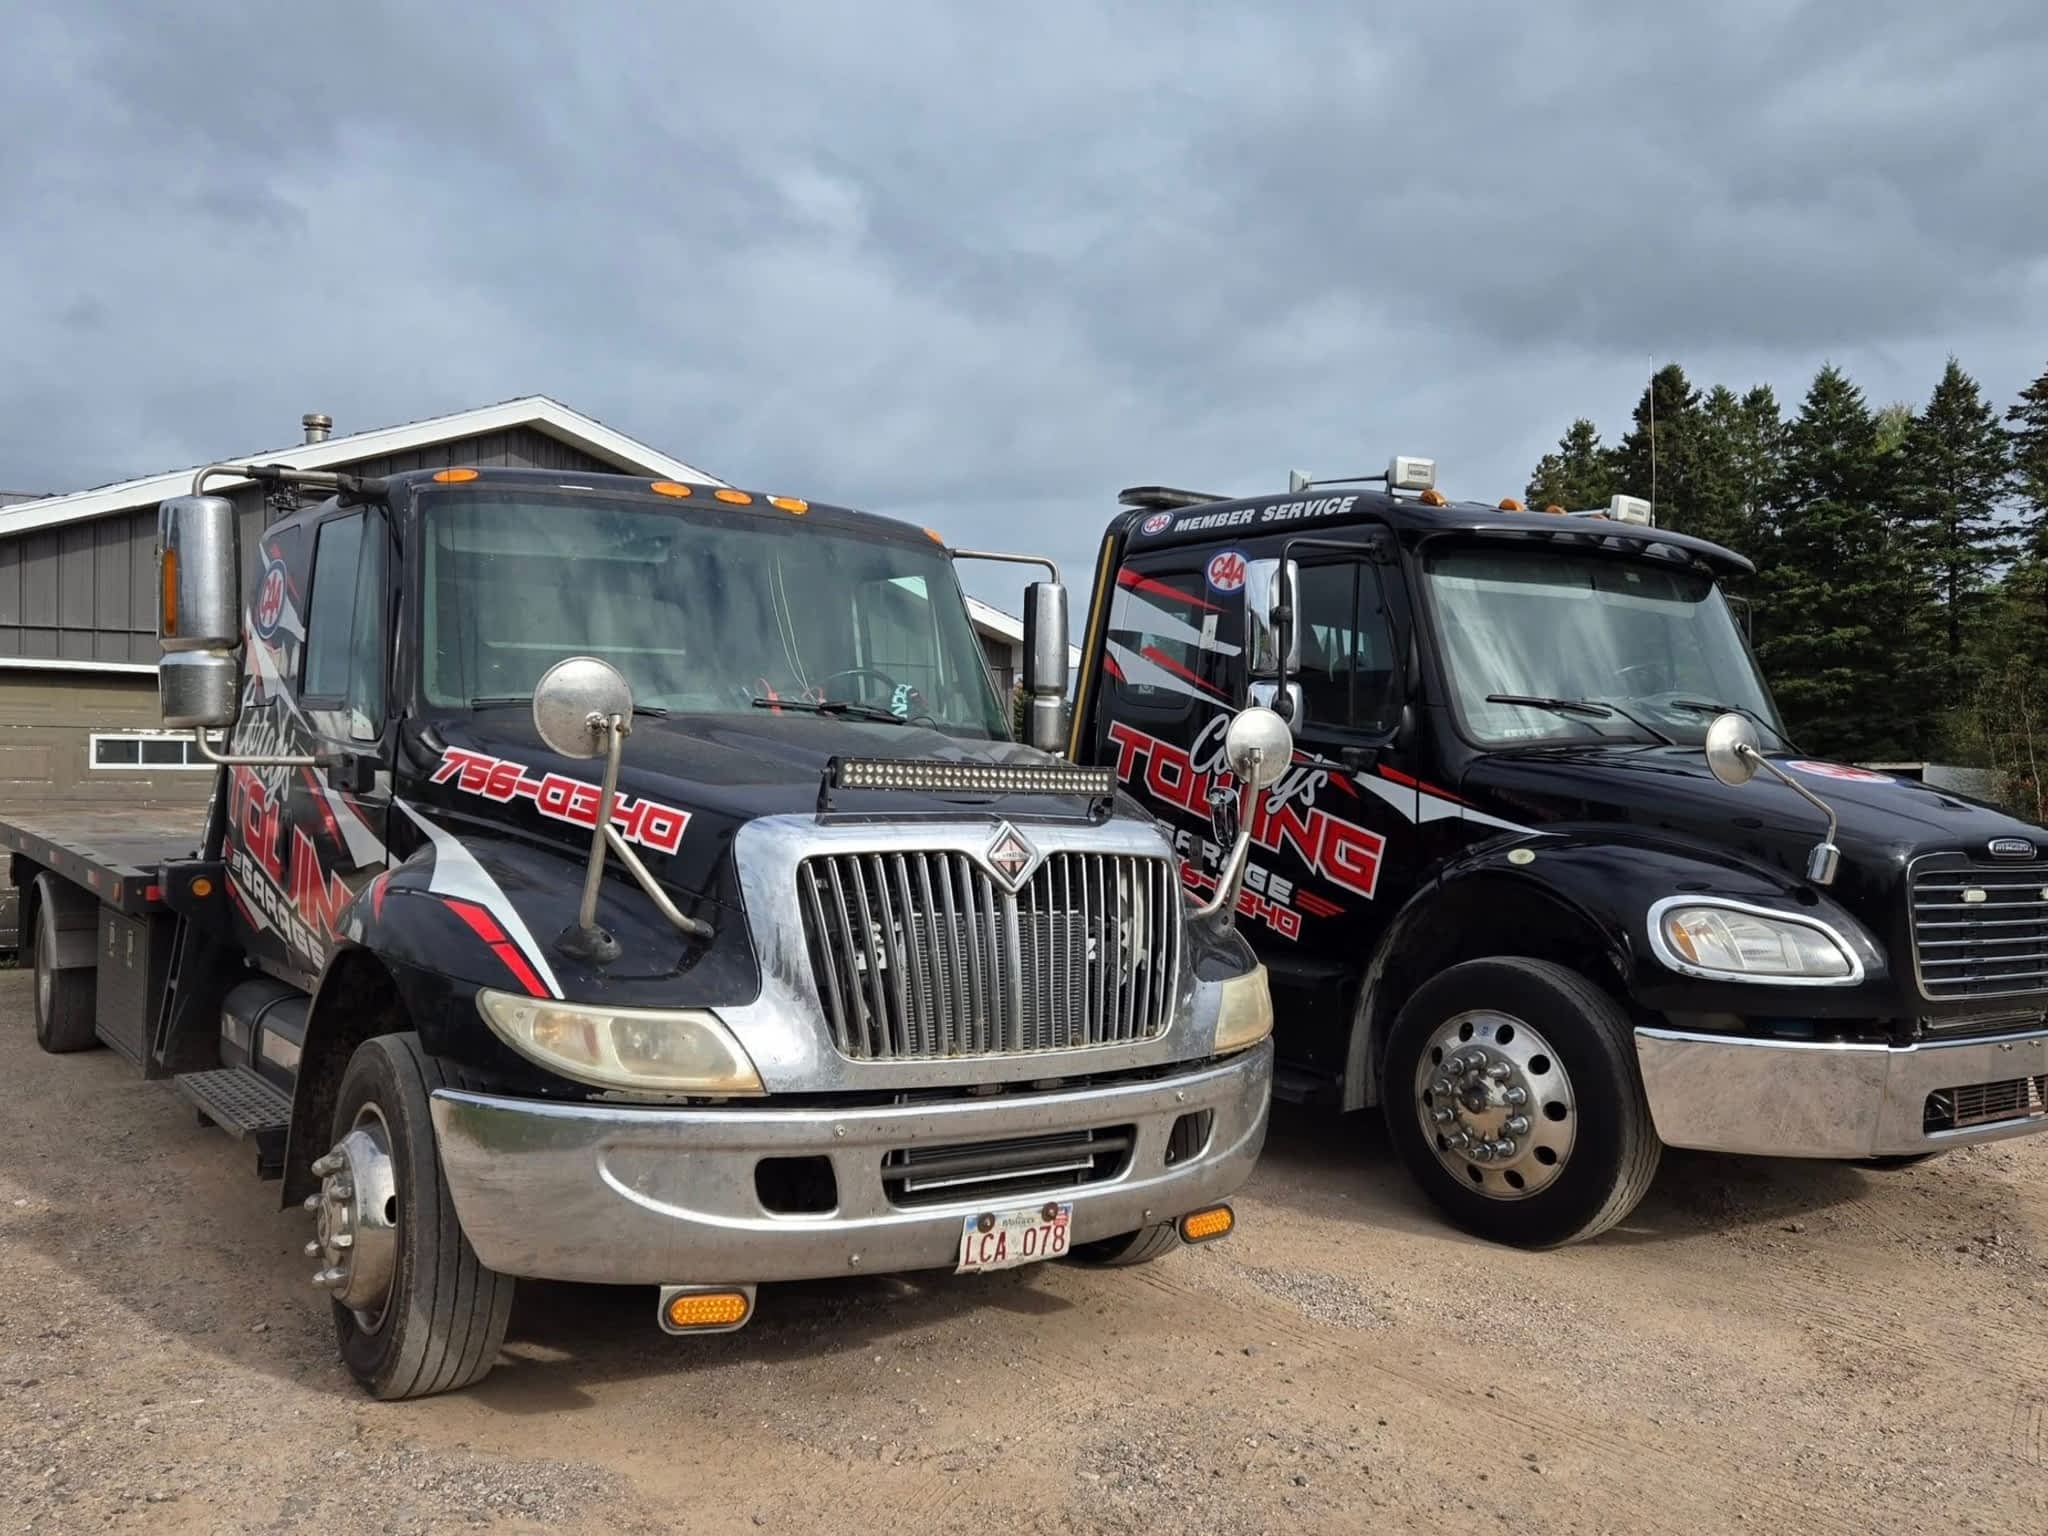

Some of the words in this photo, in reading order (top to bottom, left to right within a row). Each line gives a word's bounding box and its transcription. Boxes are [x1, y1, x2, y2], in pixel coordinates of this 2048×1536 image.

[1174, 509, 1255, 532] MEMBER
[1261, 496, 1359, 522] SERVICE
[1211, 552, 1246, 588] CAA
[229, 742, 355, 942] TOWIN
[429, 745, 692, 856] 756-0340
[1156, 818, 1293, 905] ARGE
[242, 853, 325, 973] GARAGE
[964, 1231, 1006, 1266] LCA
[1023, 1225, 1066, 1257] 078
